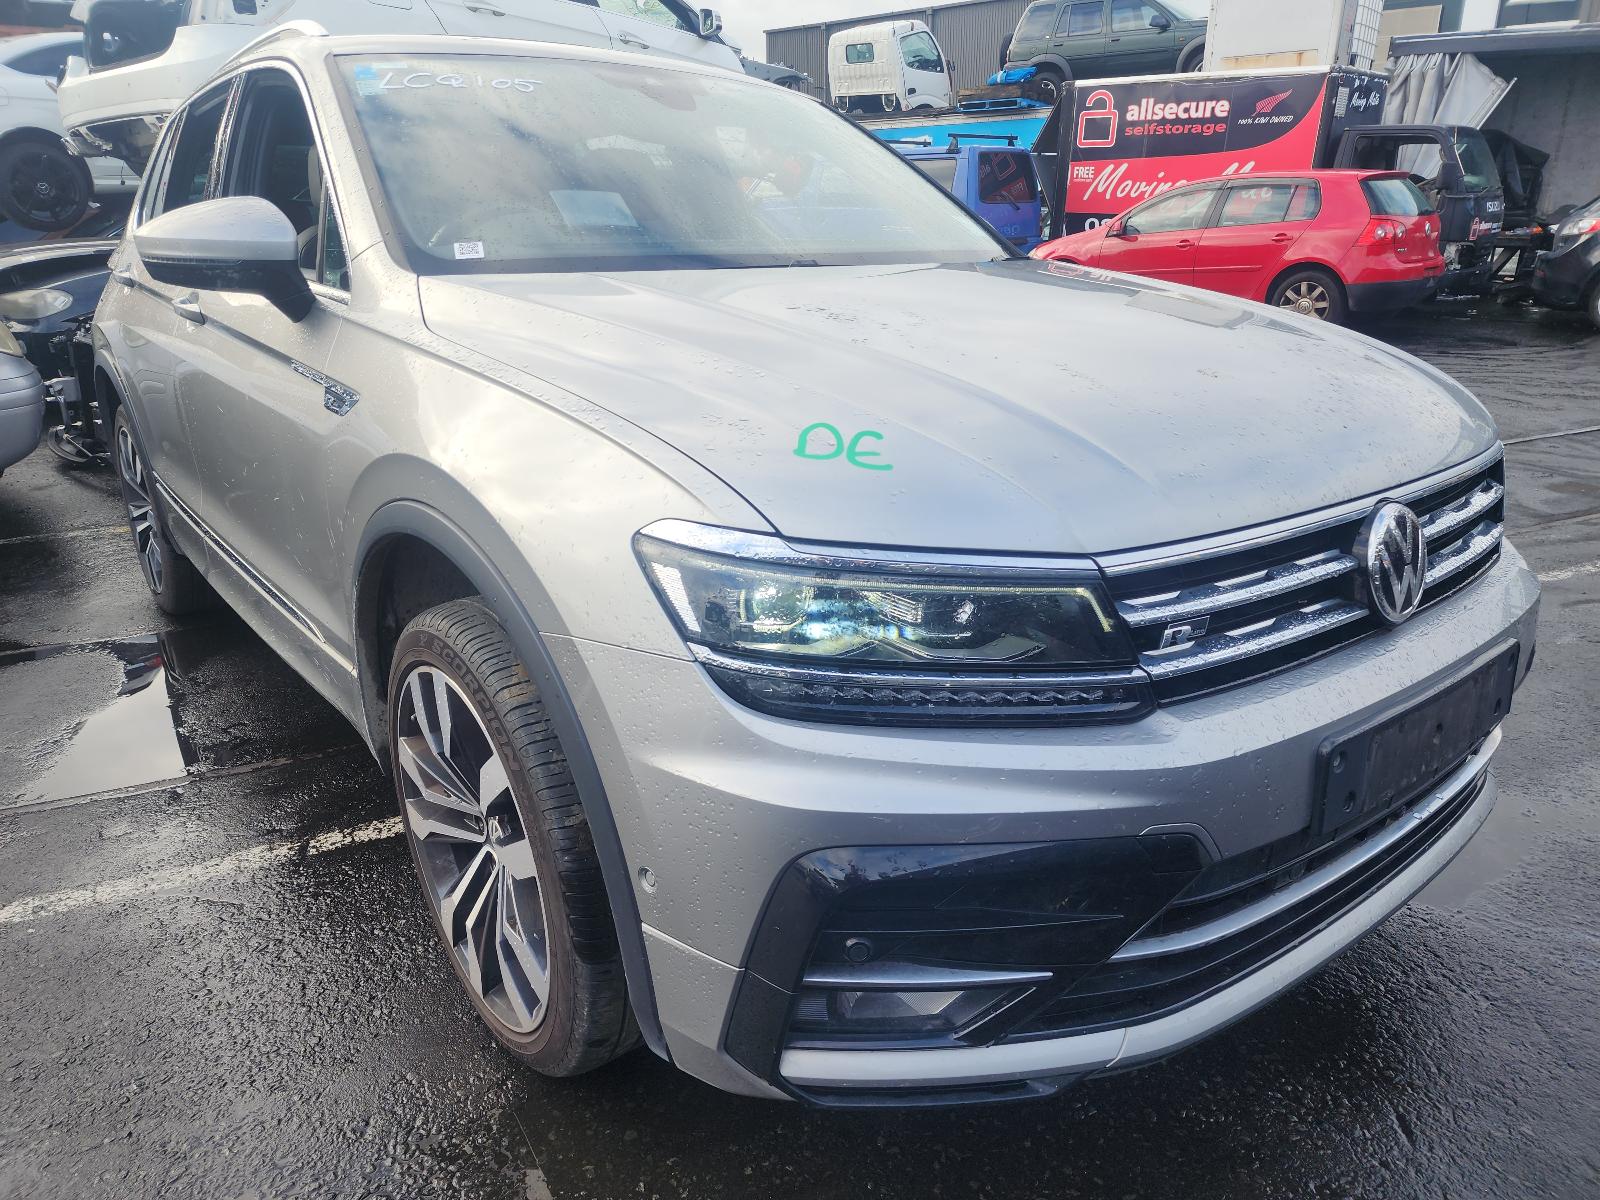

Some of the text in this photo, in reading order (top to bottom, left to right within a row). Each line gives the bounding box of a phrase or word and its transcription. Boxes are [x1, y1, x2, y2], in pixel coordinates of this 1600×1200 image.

[1126, 98, 1230, 121] allsecure
[1270, 115, 1294, 124] OWNED
[1125, 123, 1227, 136] selfstorage
[1073, 166, 1095, 179] FREE
[1083, 163, 1187, 200] Movin
[793, 422, 893, 471] DE
[431, 638, 521, 771] SCORPION
